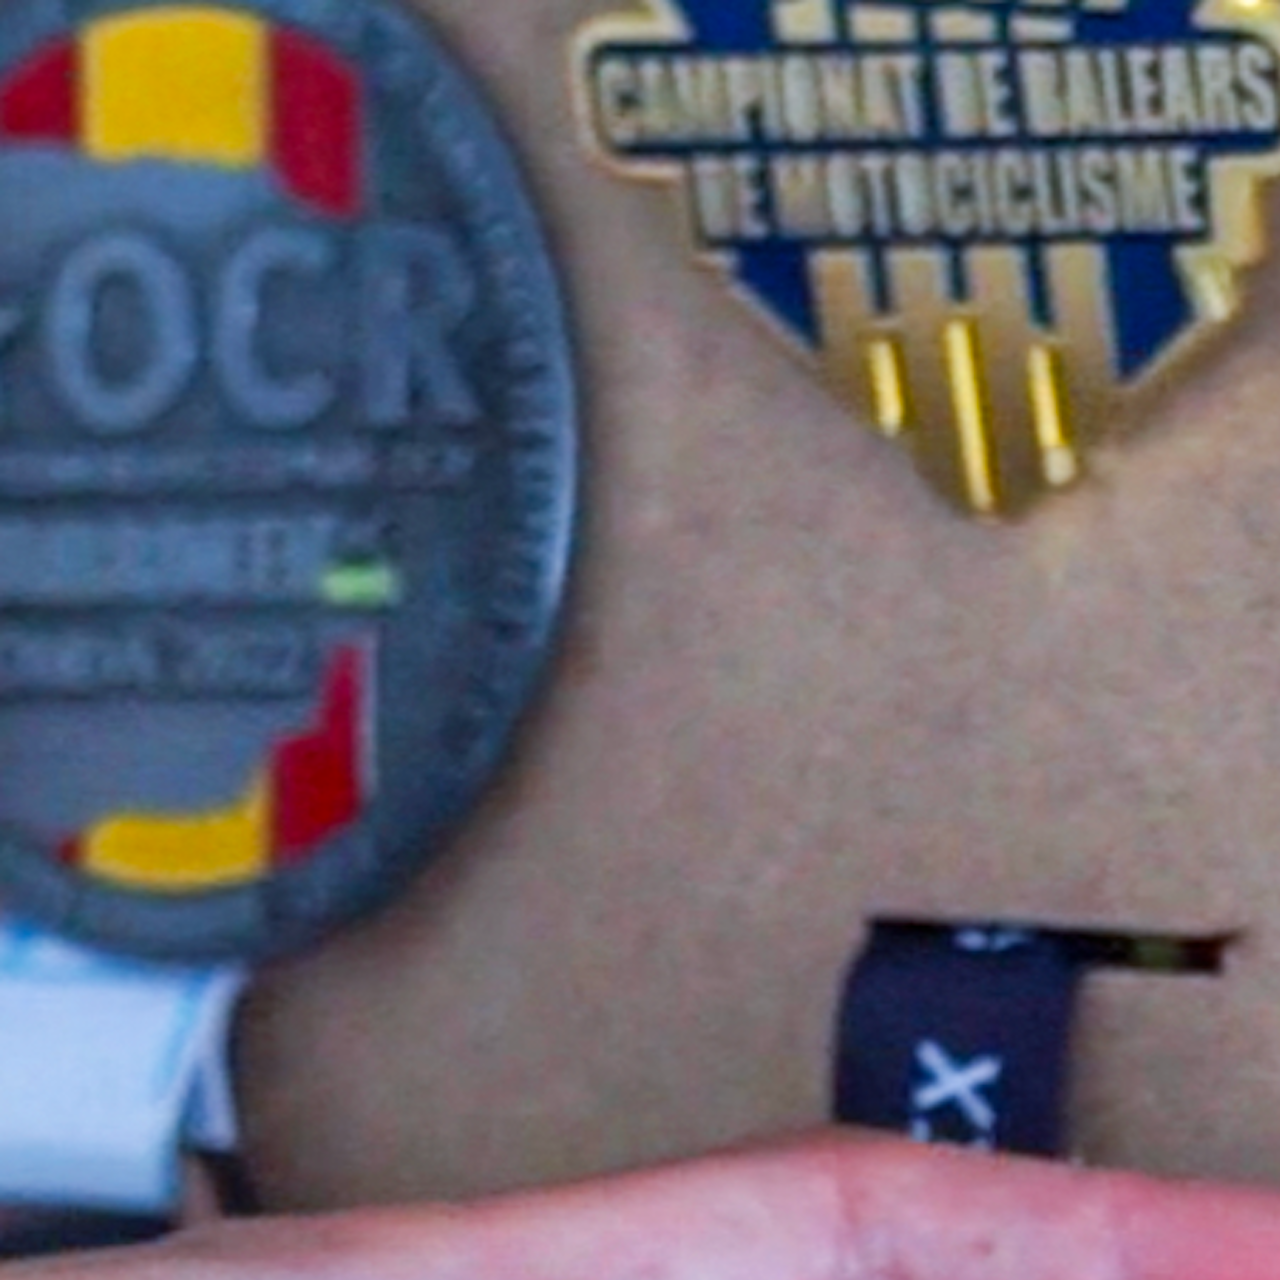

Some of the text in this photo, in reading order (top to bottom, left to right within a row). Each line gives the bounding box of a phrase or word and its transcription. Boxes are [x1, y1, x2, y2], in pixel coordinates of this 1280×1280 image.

[598, 43, 1278, 145] CAMPIONAT DE BALEARS
[692, 146, 1204, 240] DE MOTOCICLISME
